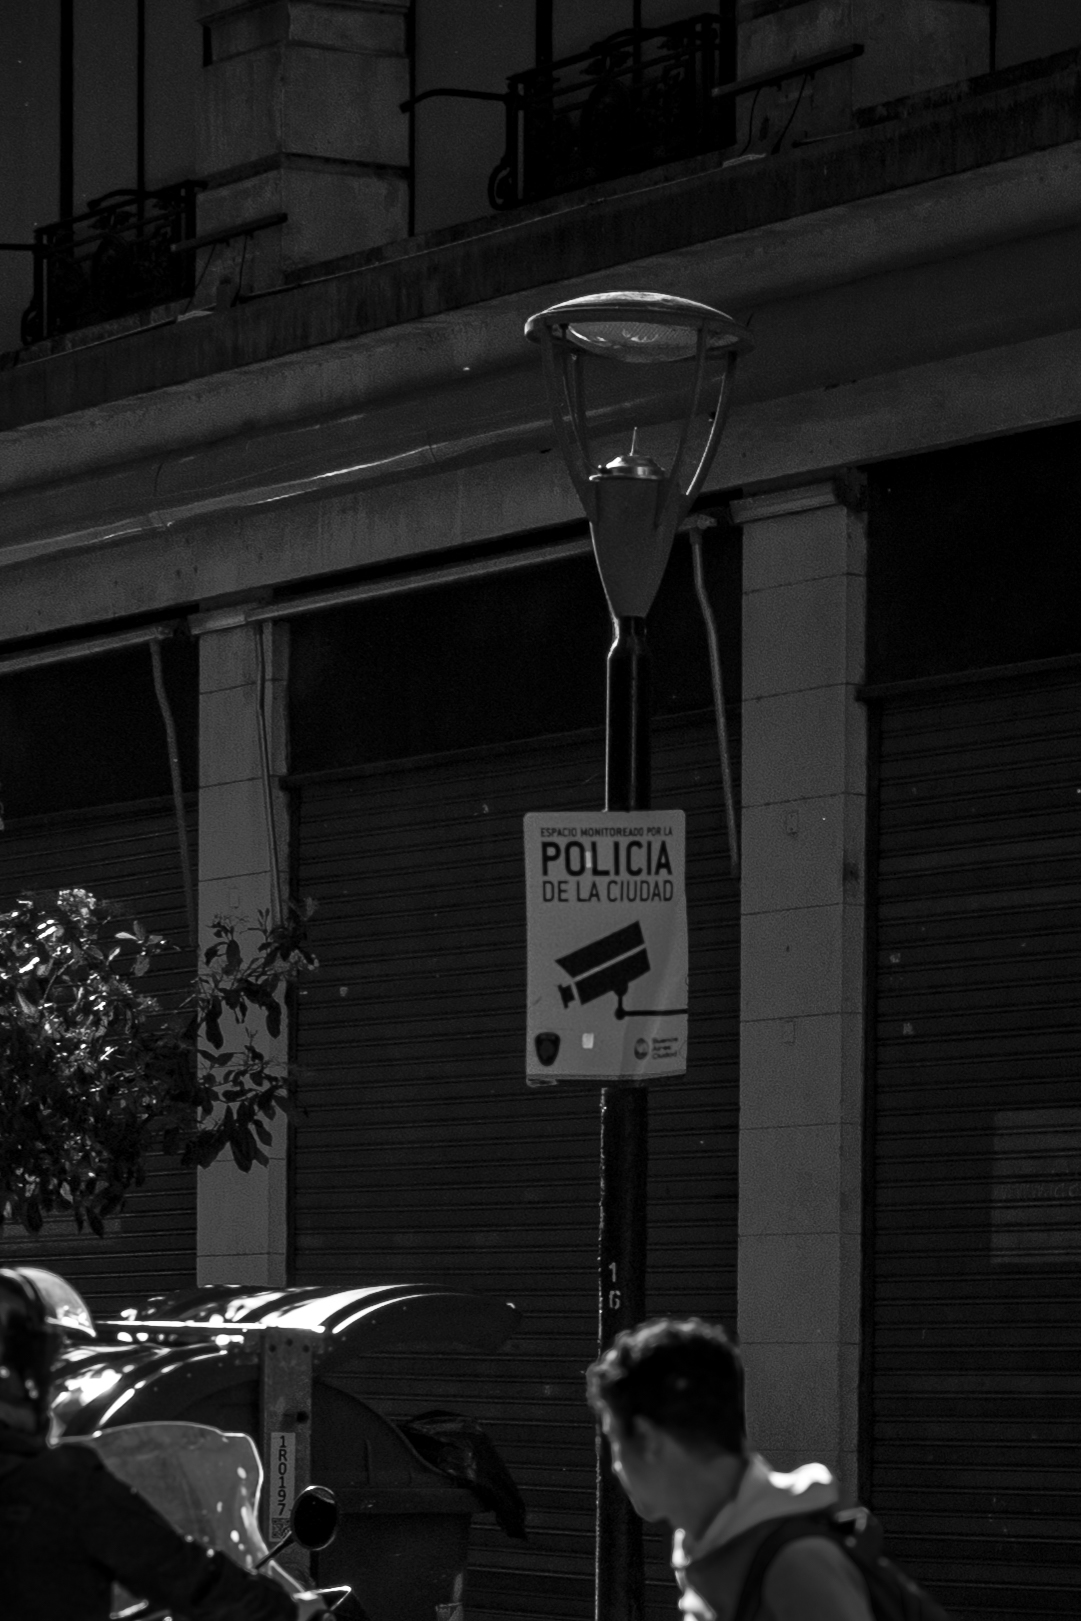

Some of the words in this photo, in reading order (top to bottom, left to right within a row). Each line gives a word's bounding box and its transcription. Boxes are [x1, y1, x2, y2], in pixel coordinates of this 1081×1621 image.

[541, 827, 578, 837] ESPACIO
[580, 827, 644, 837] MONITOREADO
[646, 827, 661, 837] POR
[663, 826, 673, 836] LA
[541, 840, 673, 876] POLICIA
[542, 880, 569, 902] DE
[576, 880, 601, 902] LA
[607, 880, 674, 902] CIUDAD
[277, 1435, 288, 1516] 1R0197
